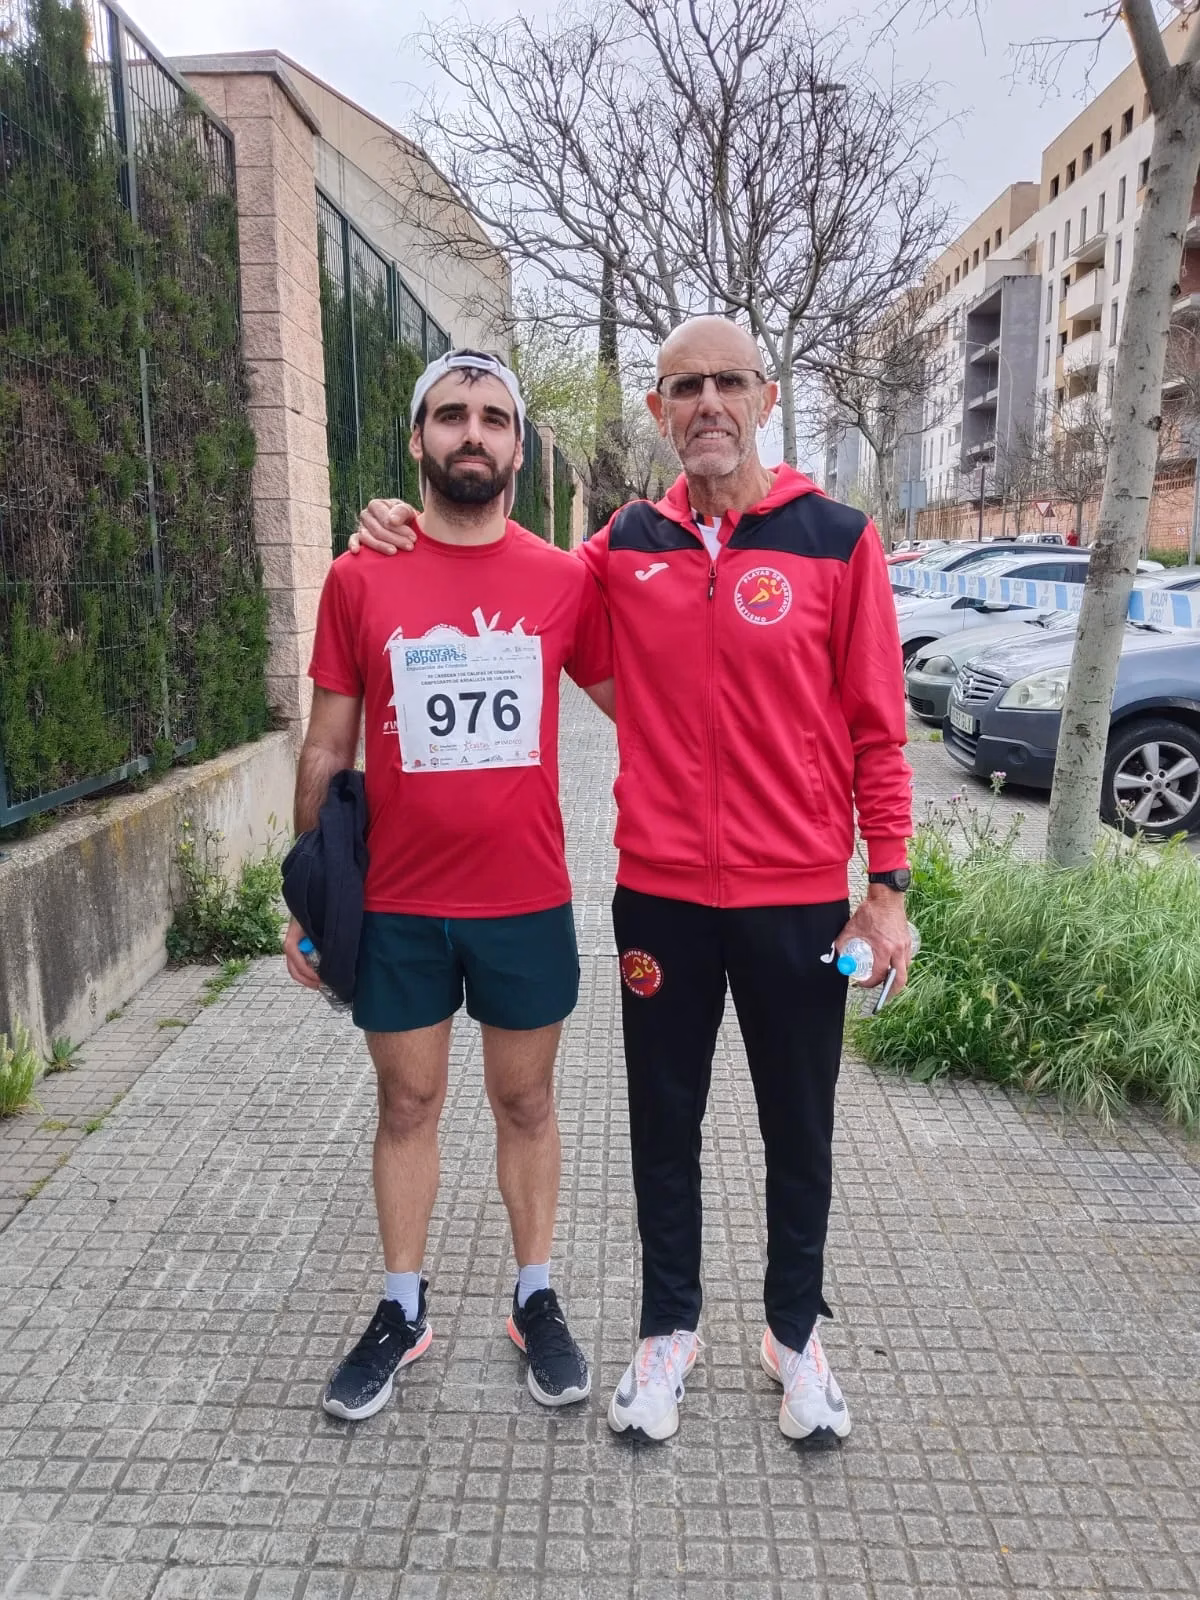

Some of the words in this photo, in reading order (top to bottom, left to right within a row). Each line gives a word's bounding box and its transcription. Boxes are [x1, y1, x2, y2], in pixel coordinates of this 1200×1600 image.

[743, 570, 770, 584] PLAYAS
[736, 592, 767, 622] ATLETISMO
[405, 647, 457, 659] carreras
[405, 653, 468, 667] populares
[426, 689, 521, 737] 976
